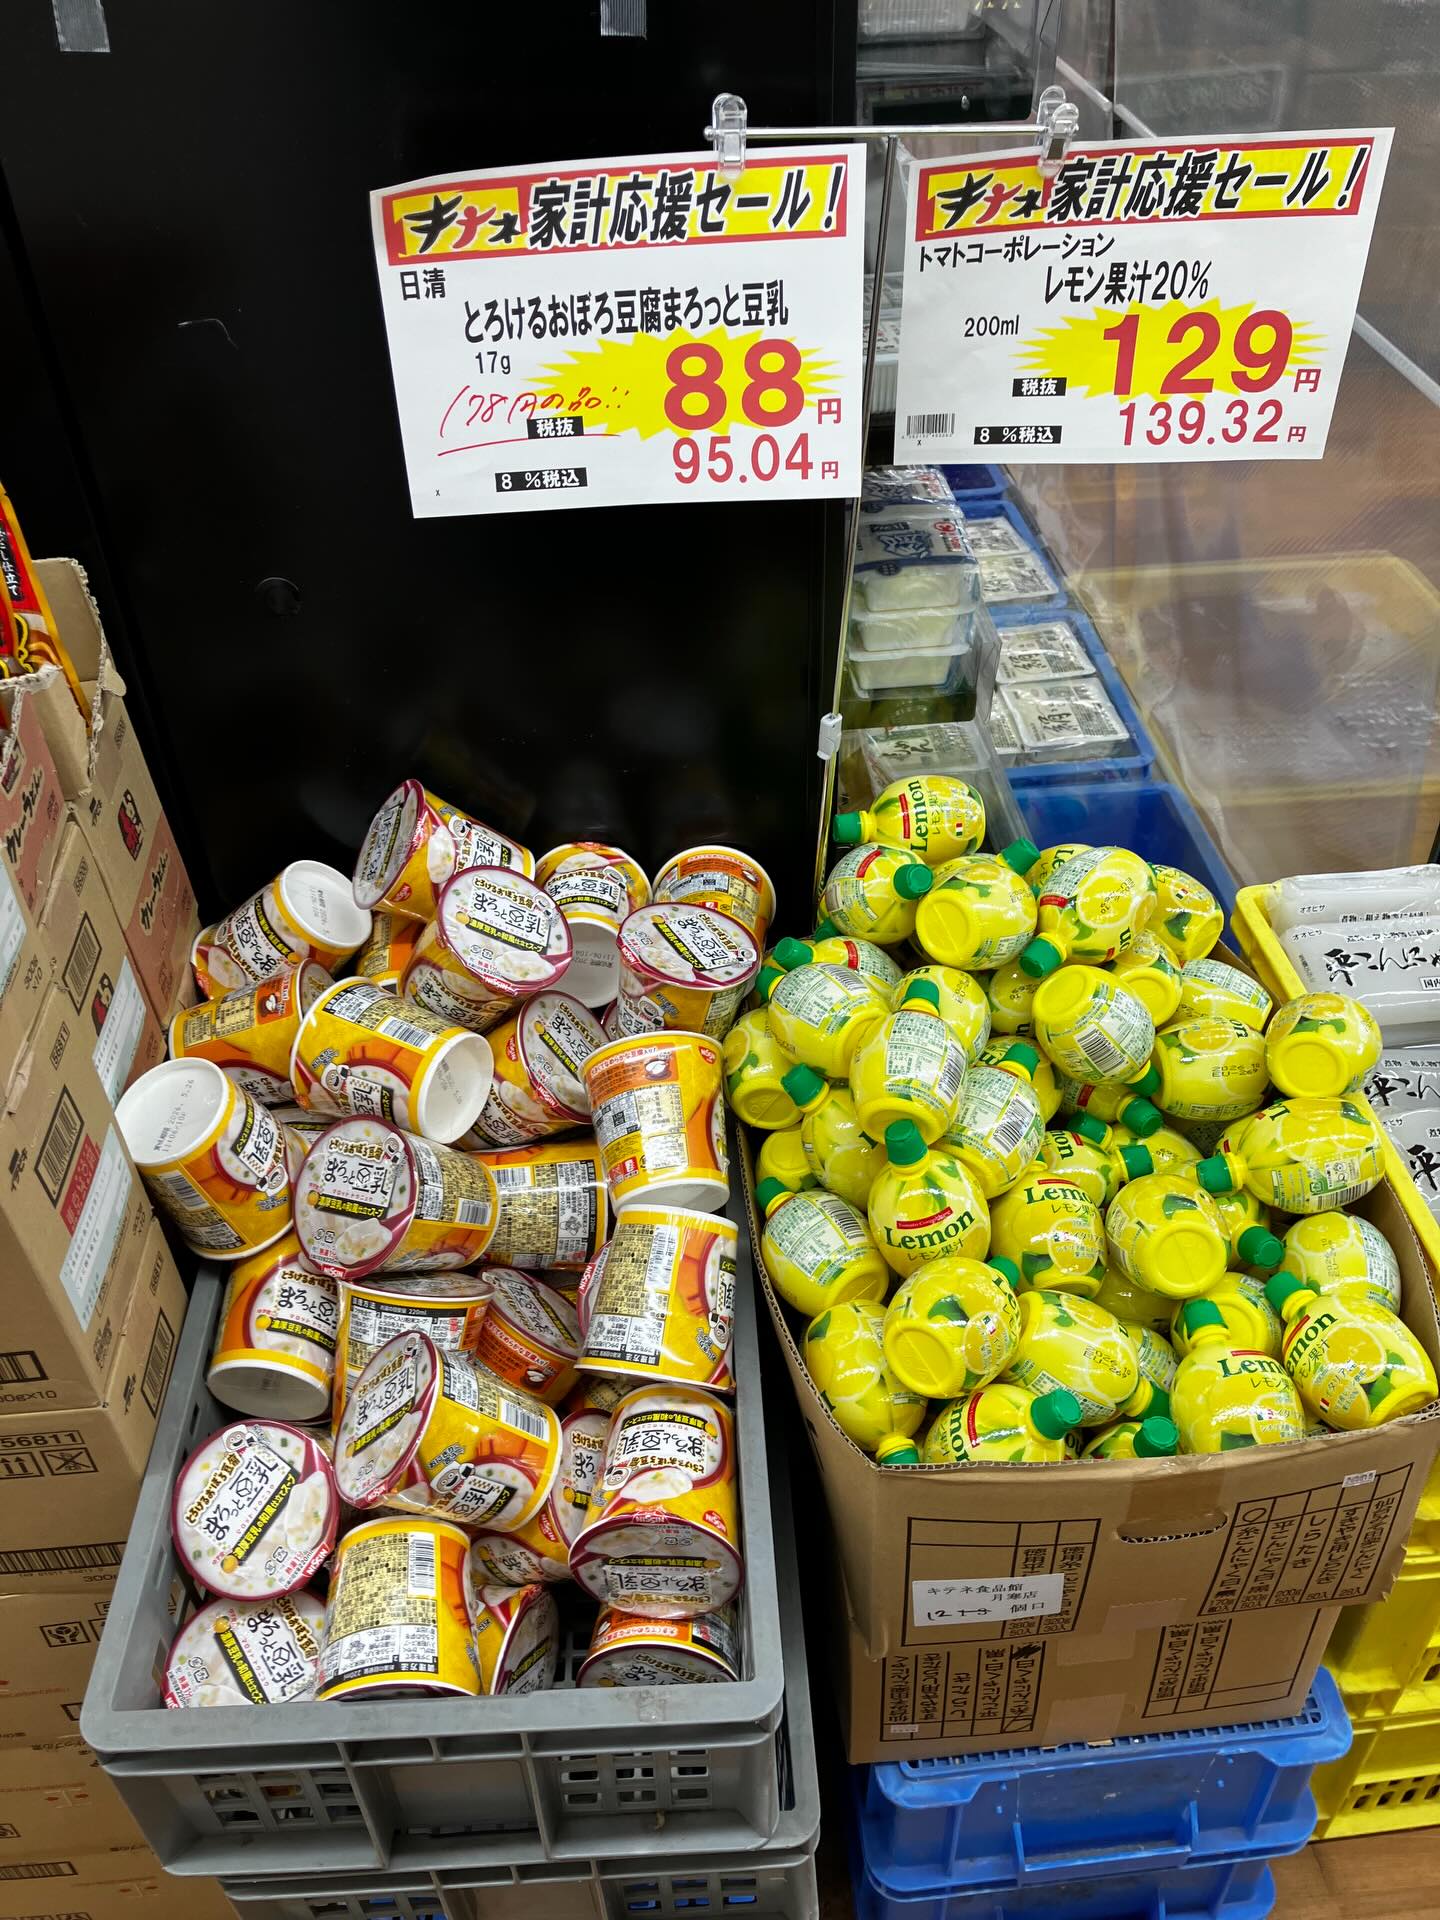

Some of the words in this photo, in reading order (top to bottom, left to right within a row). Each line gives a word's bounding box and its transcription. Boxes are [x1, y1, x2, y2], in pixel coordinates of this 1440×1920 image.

[919, 233, 1115, 272] トマトコーポレーション
[400, 268, 446, 300] 日清
[1044, 259, 1213, 305] レモン果汁20%
[464, 279, 789, 343] とろけるおぼろ豆腐まろっと豆乳
[964, 315, 1020, 338] 200ml
[475, 350, 511, 375] 17g
[1103, 309, 1293, 396] 129
[1293, 368, 1321, 393] 円
[663, 339, 804, 431] 88
[817, 398, 842, 425] 円
[1021, 378, 1058, 397] 税抜
[536, 417, 575, 437] 税抜
[1002, 426, 1054, 444] %税込
[1119, 399, 1283, 446] 139.32
[1287, 426, 1306, 442] 円
[672, 432, 813, 484] 95.04
[821, 460, 840, 479] 円
[525, 470, 581, 489] %税込
[908, 780, 928, 852] Lemon
[473, 892, 545, 937] まろっと豆乳
[1300, 903, 1326, 914] オオヒサ
[678, 918, 728, 968] まろっと豆乳
[1292, 929, 1322, 941] オオヒサ
[328, 1138, 384, 1161] とろけるおぼろ豆腐
[325, 1158, 389, 1196] まろっと豆乳
[883, 1209, 976, 1250] Lemon
[907, 1238, 965, 1262] レモン果汁
[579, 1265, 592, 1291] NISSIN
[357, 1368, 412, 1426] まろっと豆乳
[1, 1433, 77, 1447] 56811
[622, 1430, 704, 1457] まろっと豆乳
[185, 1453, 242, 1524] とろけるおぼろ豆腐
[203, 1455, 279, 1541] まろっと豆乳
[233, 1473, 296, 1559] 濃厚豆乳の和風仕立てスープ
[1292, 1514, 1328, 1569] しらたき
[307, 1547, 328, 1576] NISSIN
[611, 1572, 706, 1592] まろっと豆乳
[928, 1583, 1023, 1596] キテネ食品館
[1010, 1601, 1045, 1614] 個口
[247, 1608, 305, 1697] まろっと豆乳
[951, 1672, 971, 1719] しらたき
